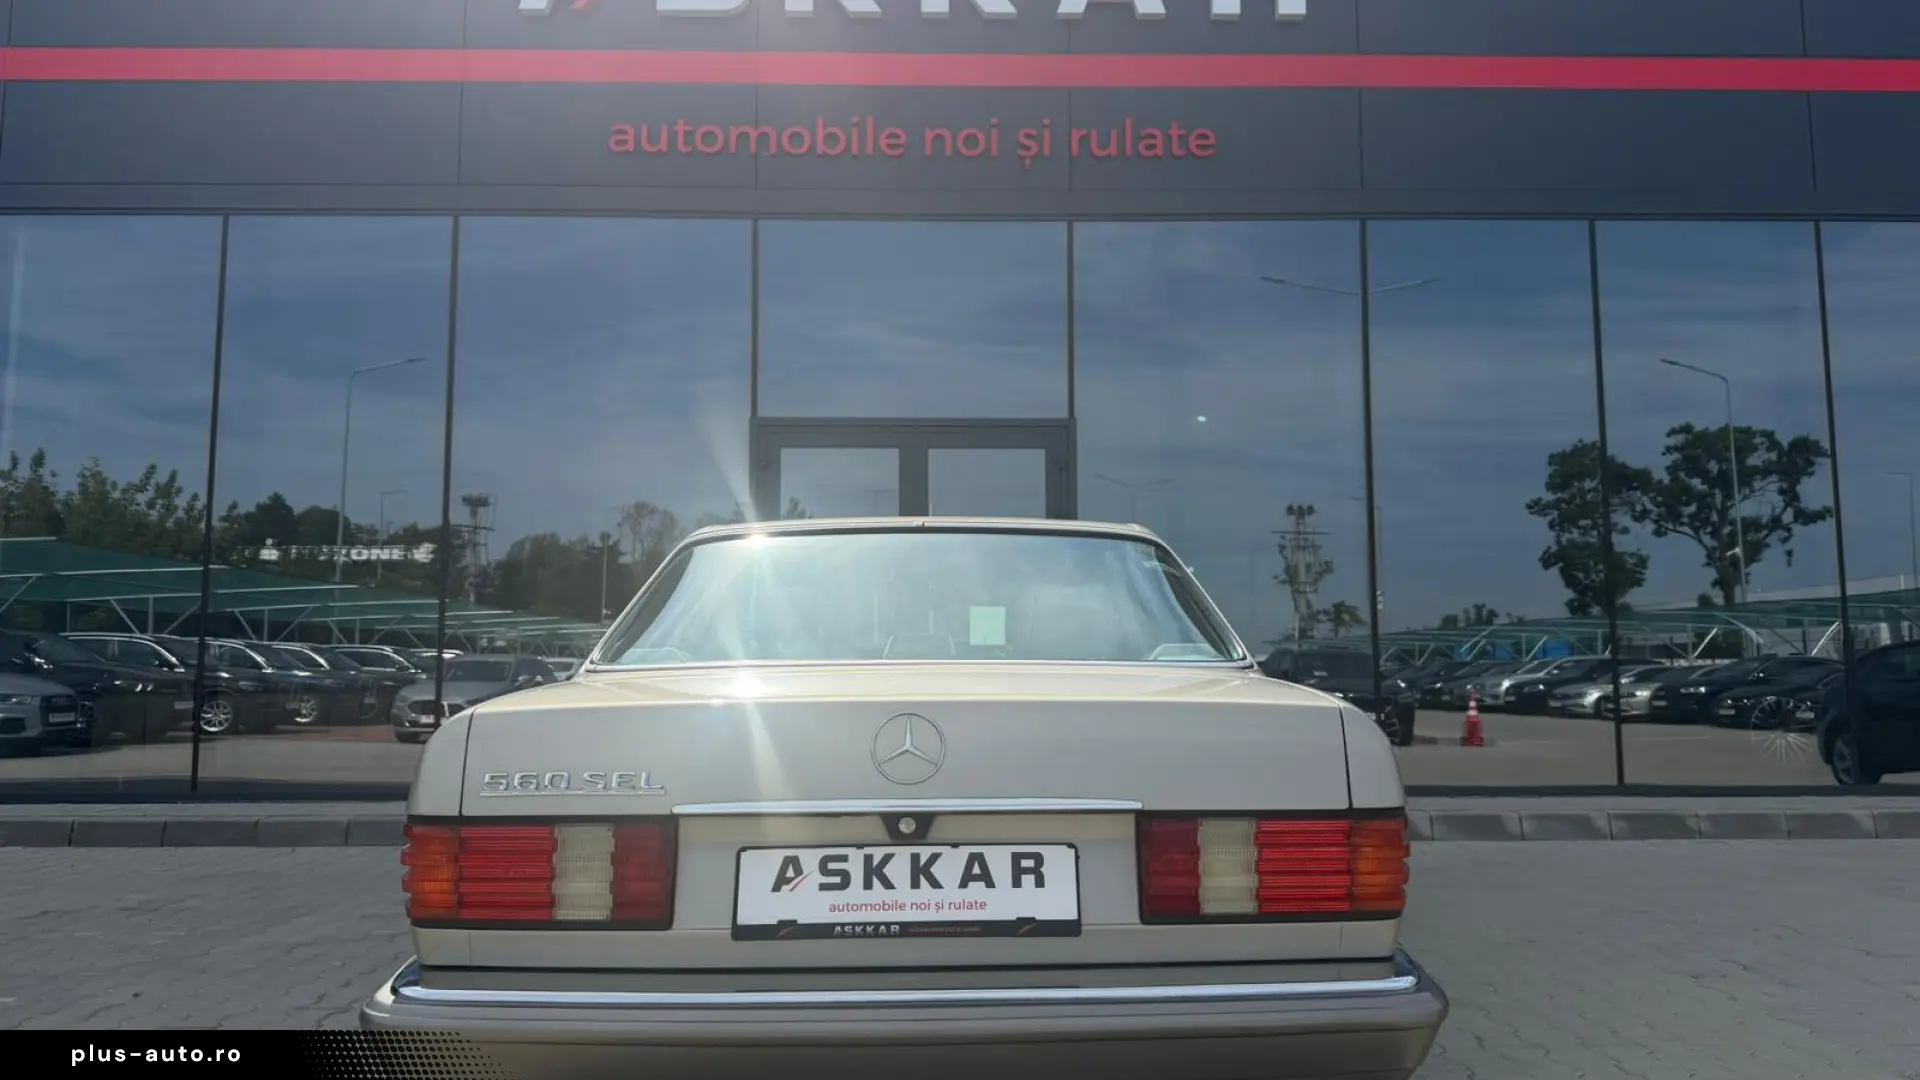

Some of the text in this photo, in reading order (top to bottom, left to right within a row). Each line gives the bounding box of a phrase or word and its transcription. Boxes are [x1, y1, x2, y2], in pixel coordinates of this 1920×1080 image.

[607, 116, 1217, 168] automobile noi și rulate
[482, 771, 665, 790] 560 SEL
[770, 851, 1046, 893] ASKKAR
[828, 899, 988, 913] automobile noi și rulate
[832, 924, 901, 937] ASKKAR
